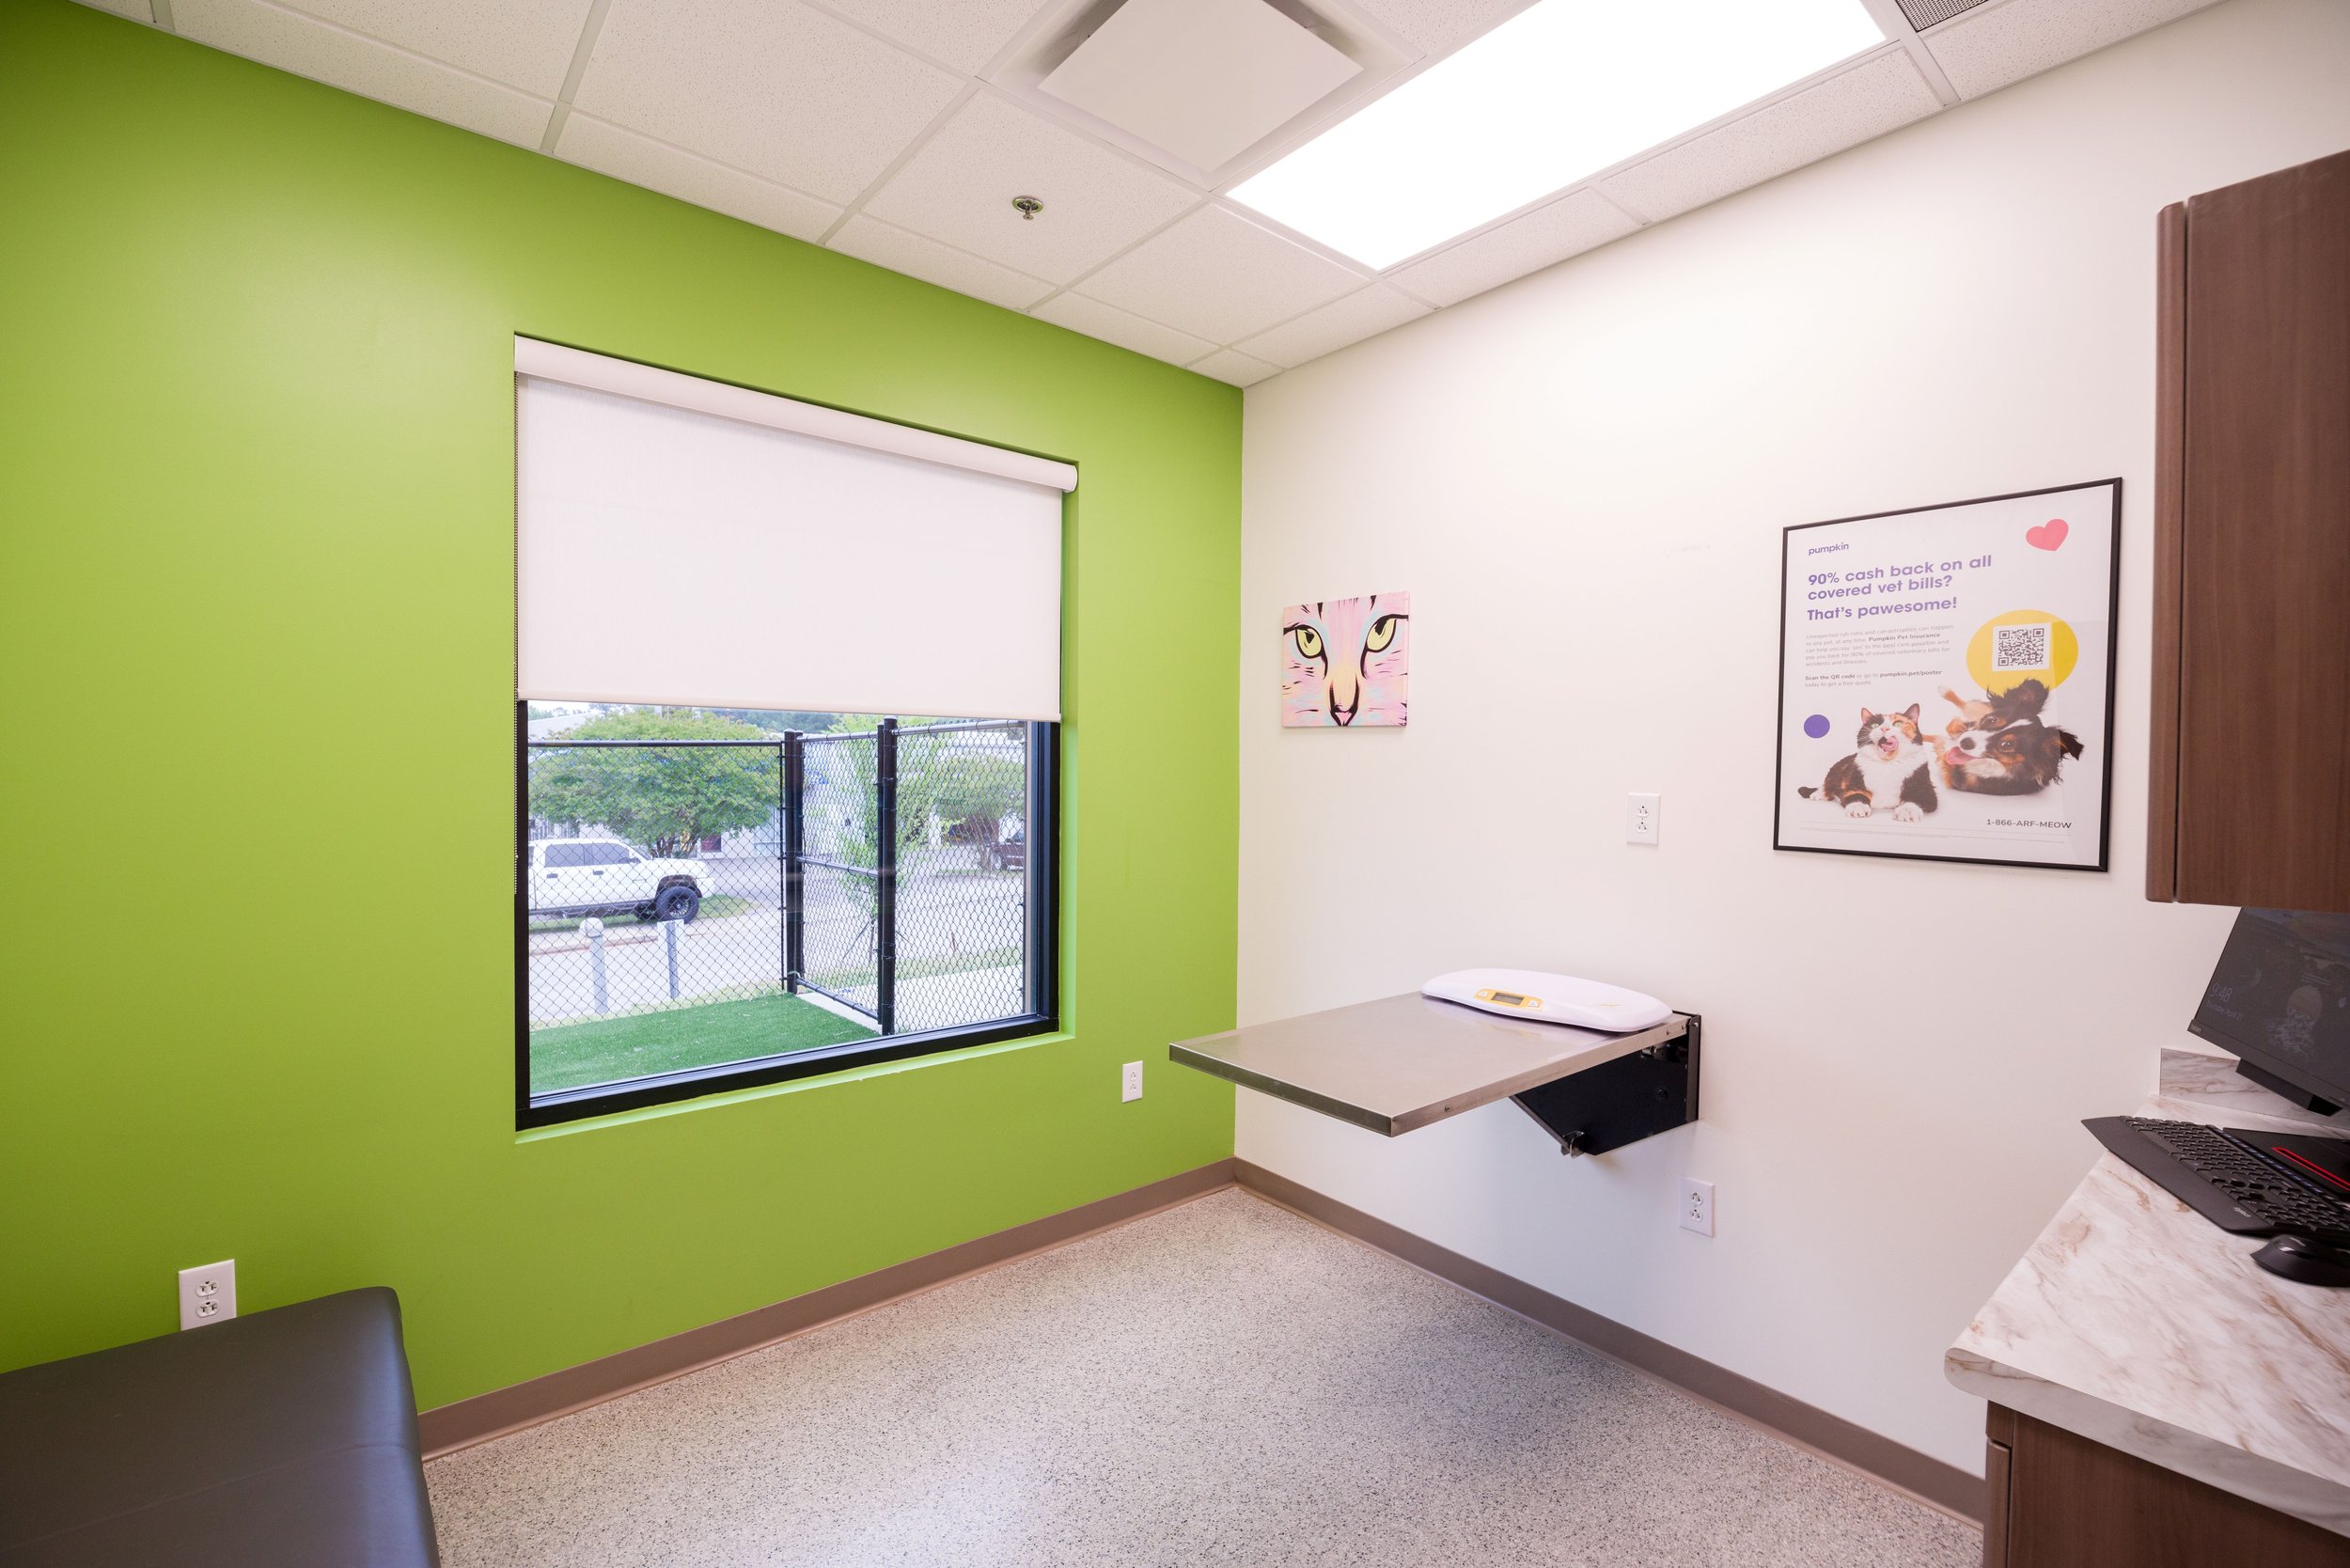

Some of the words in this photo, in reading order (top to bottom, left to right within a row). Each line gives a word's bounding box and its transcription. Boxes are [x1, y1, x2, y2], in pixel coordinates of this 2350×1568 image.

[1808, 541, 1850, 556] pumpkin
[1808, 572, 1840, 586] 90%
[1845, 567, 1885, 582] cash
[1889, 561, 1935, 577] back
[1940, 559, 1963, 572] on
[1969, 555, 1992, 568] all
[1808, 583, 1872, 600] covered
[1878, 579, 1903, 593] vet
[1908, 574, 1952, 590] bills?
[1807, 607, 1853, 620] That's
[1857, 596, 1957, 619] pawesome!
[1986, 819, 2072, 829] 1-866-ARF-MEOW
